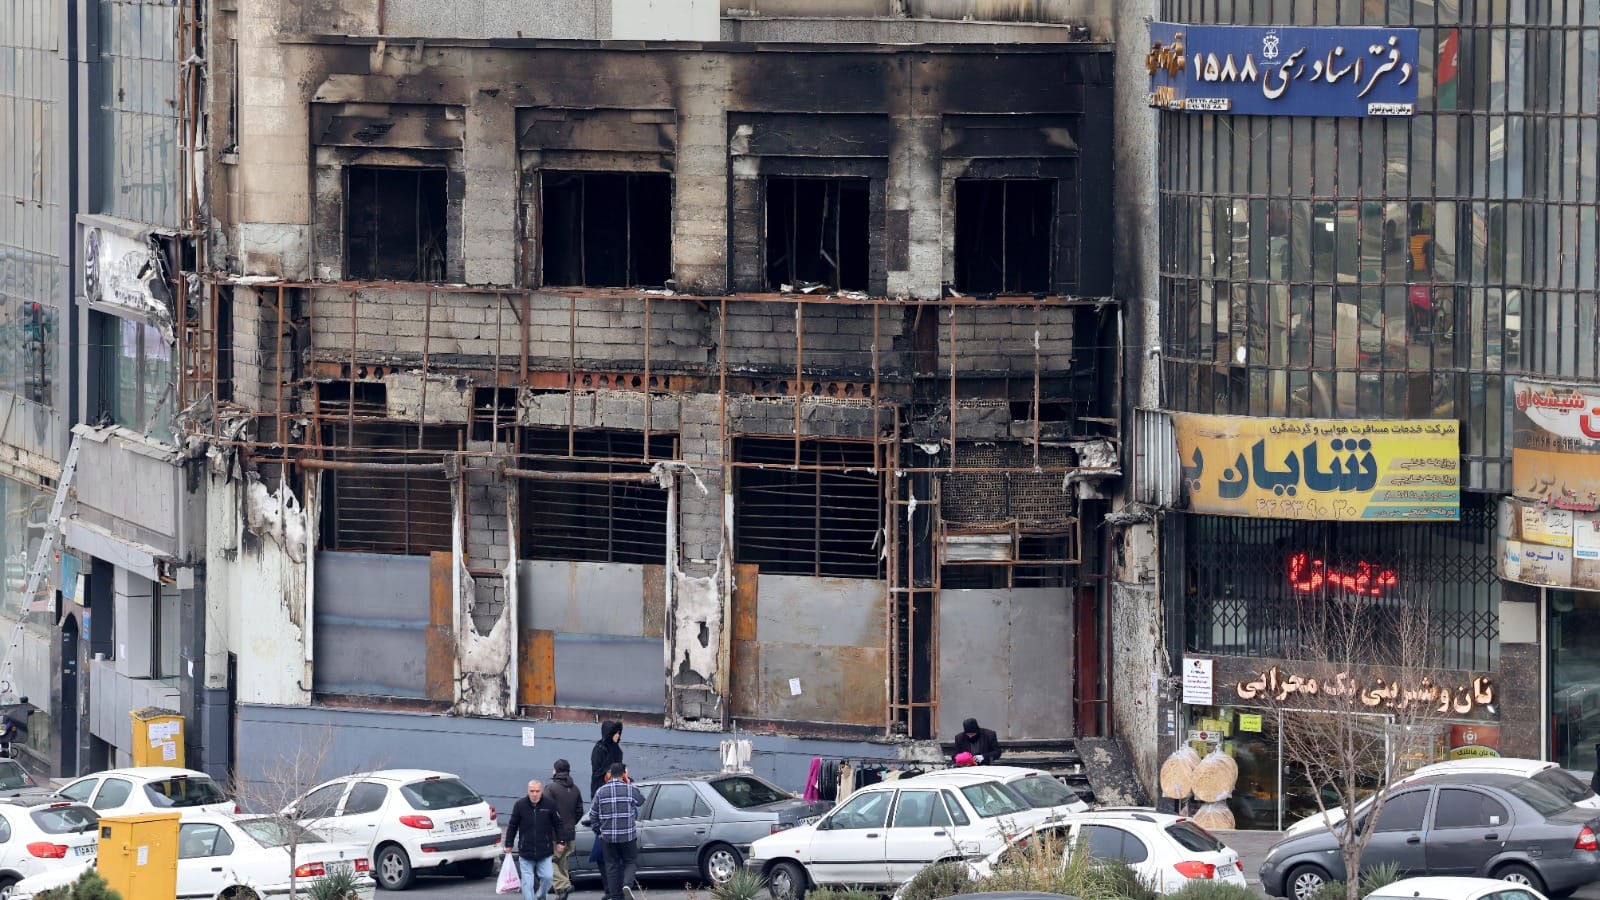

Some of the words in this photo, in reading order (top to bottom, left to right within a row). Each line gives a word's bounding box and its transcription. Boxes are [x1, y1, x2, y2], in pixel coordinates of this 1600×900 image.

[1193, 52, 1259, 83] ۱۵۸۸
[1262, 47, 1306, 99] رسمی
[1309, 46, 1363, 84] اسناد
[1357, 36, 1413, 98] دفتر
[1269, 422, 1311, 435] گردشگری
[1313, 426, 1319, 435] و
[1320, 424, 1348, 435] هوایی
[1350, 424, 1388, 435] مسافرت
[1391, 424, 1423, 434] خدمات
[1424, 423, 1455, 435] شرکت
[1217, 438, 1378, 500] شایان
[1362, 676, 1437, 709] شیرینی
[1437, 688, 1450, 712] و
[1453, 676, 1494, 714] نان
